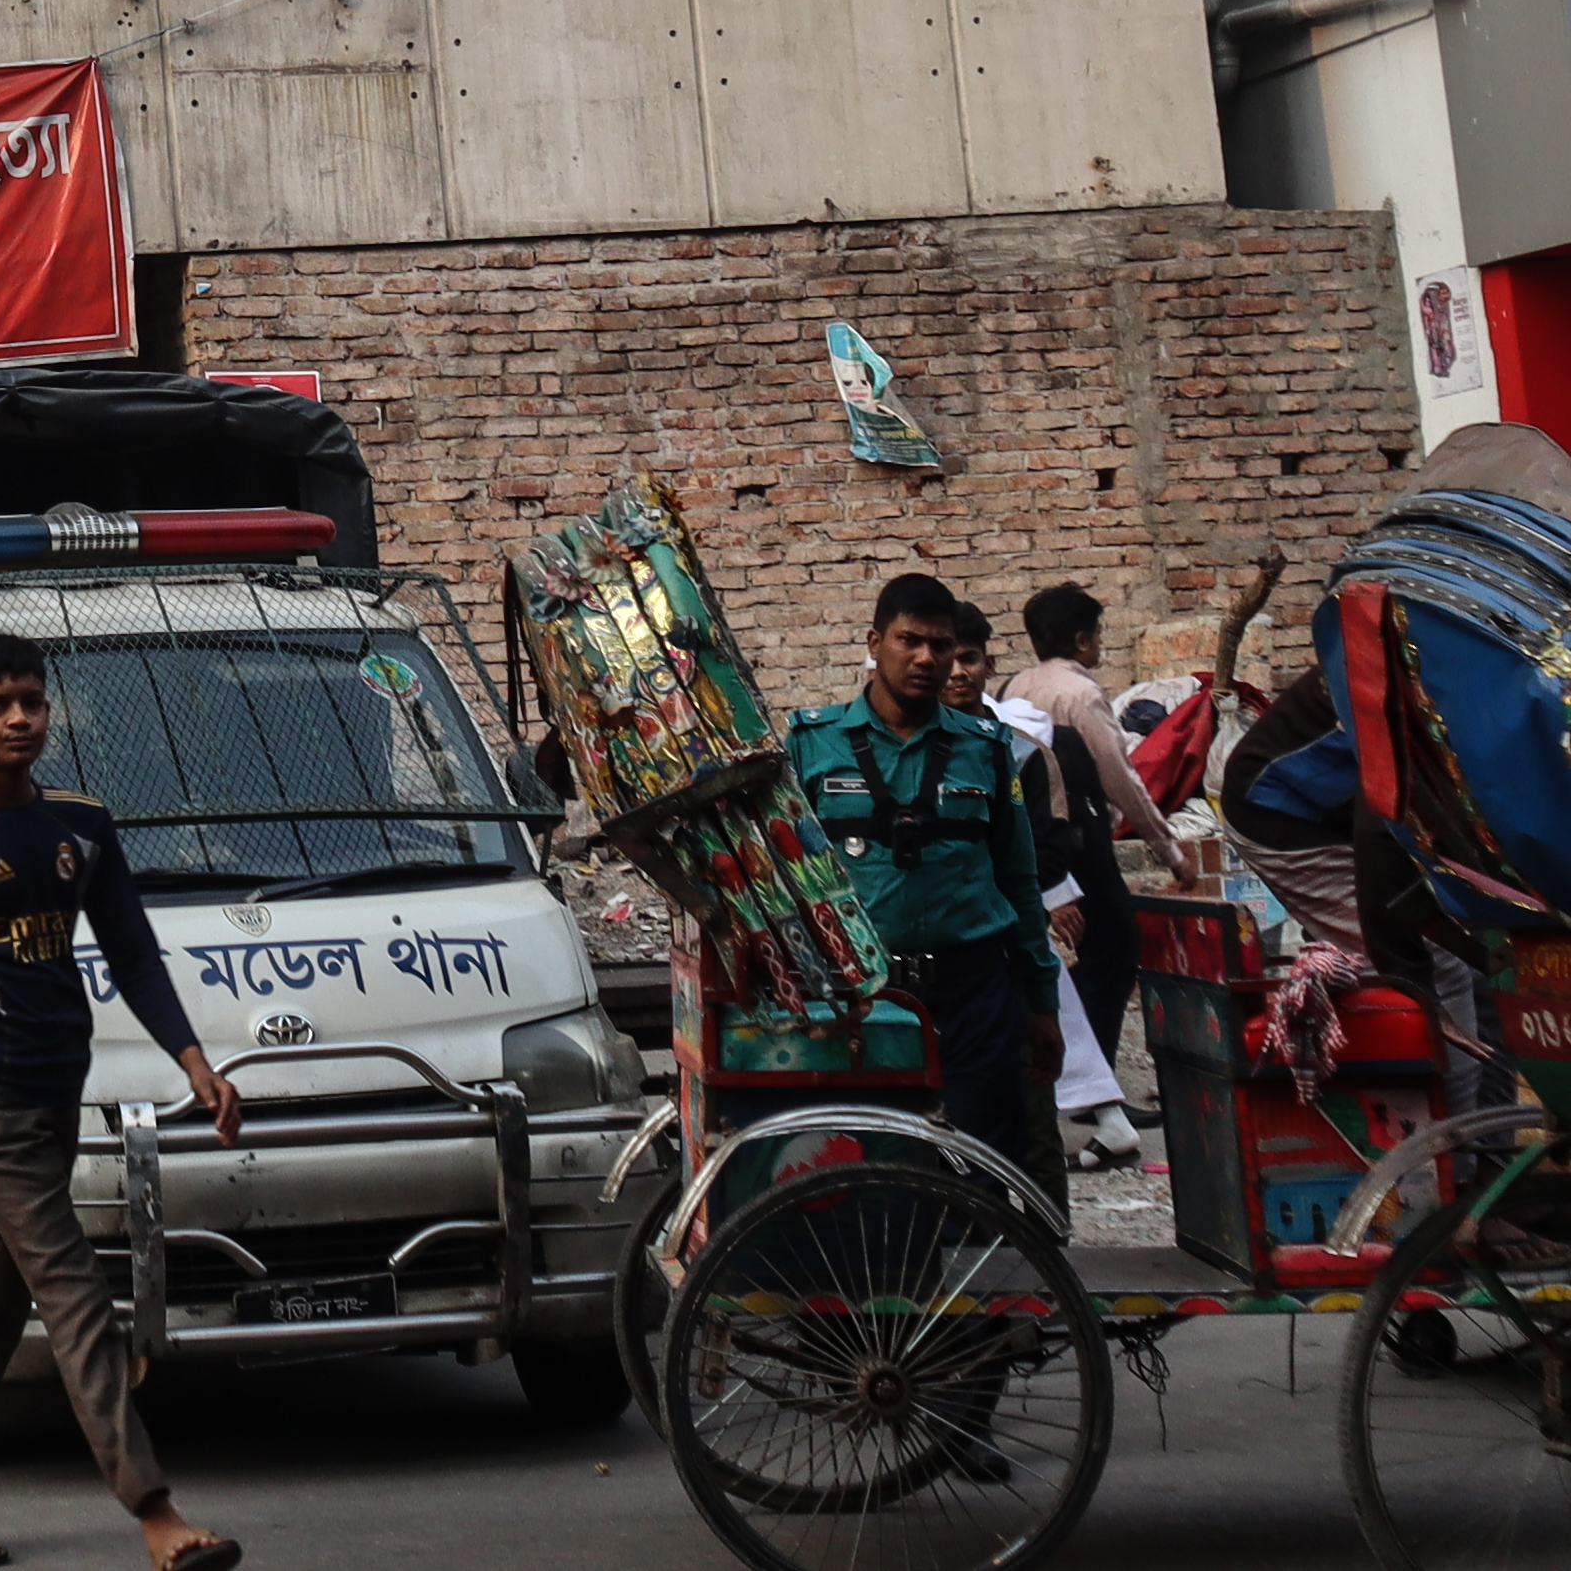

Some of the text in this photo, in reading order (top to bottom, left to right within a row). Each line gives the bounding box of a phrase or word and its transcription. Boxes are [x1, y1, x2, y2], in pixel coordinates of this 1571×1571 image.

[182, 938, 367, 1000] মডেল
[387, 930, 511, 998] থানা
[270, 1296, 332, 1324] ইঞ্জিন
